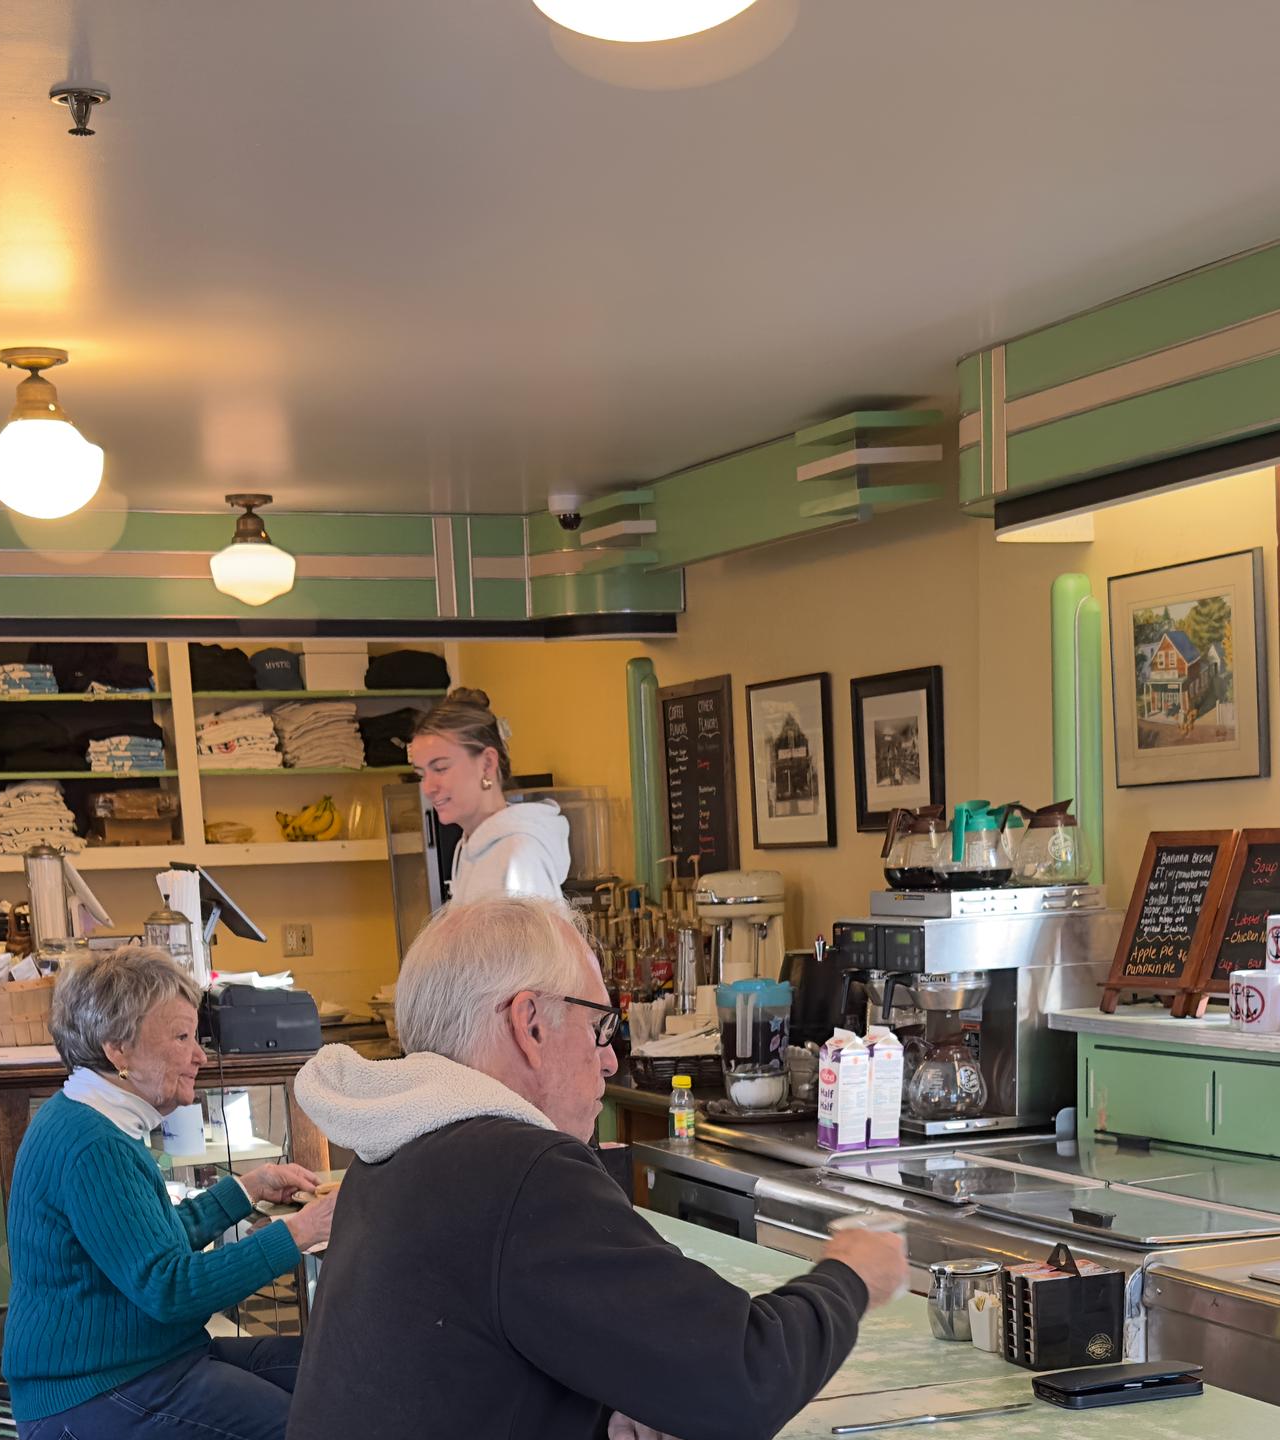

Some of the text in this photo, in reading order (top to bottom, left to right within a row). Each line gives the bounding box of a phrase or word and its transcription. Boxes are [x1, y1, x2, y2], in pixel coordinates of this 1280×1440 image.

[1252, 858, 1279, 875] Soup
[1130, 945, 1157, 963] Apple
[821, 1089, 834, 1099] Half
[820, 1102, 833, 1112] Half
